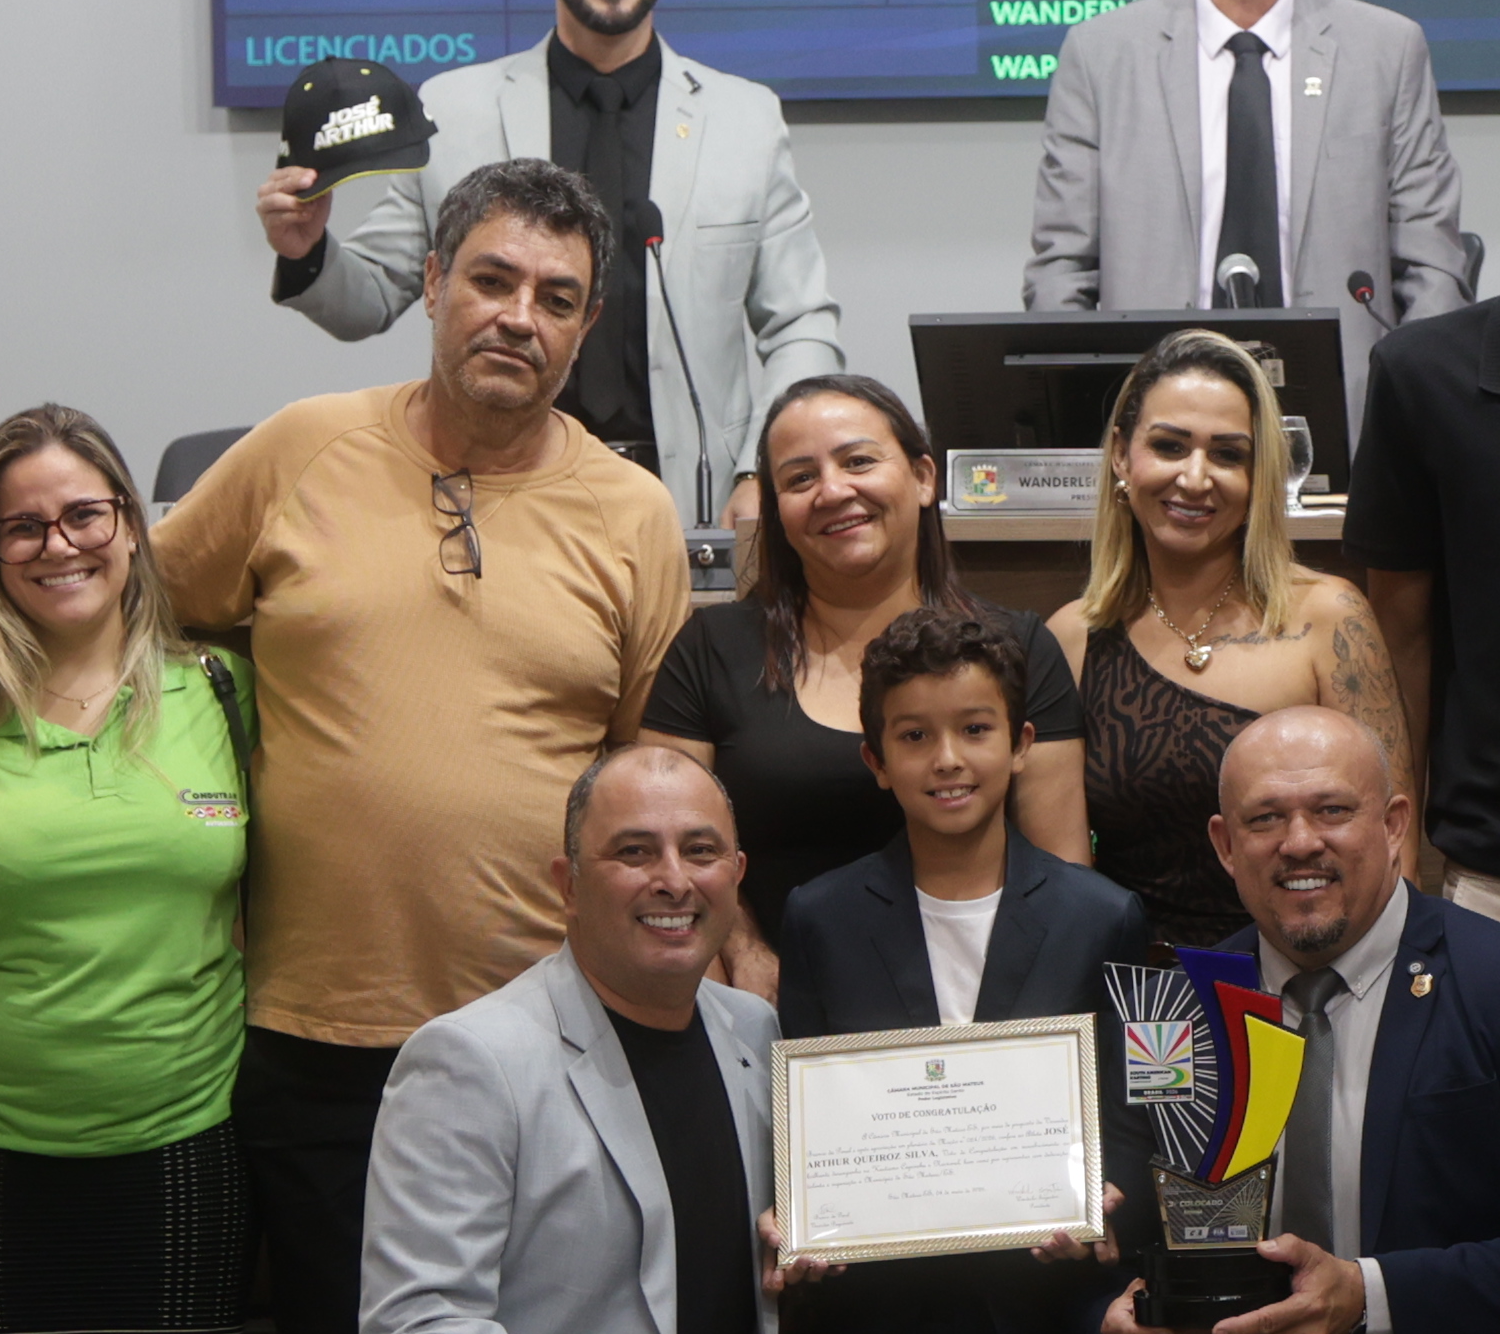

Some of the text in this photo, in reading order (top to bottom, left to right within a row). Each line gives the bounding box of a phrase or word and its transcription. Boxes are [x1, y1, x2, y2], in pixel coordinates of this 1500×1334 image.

[246, 35, 476, 67] LICENCIADOS
[321, 95, 381, 130] JOSÉ
[313, 113, 395, 151] ARTHUR
[1018, 475, 1097, 488] WANDERLEI
[871, 1103, 997, 1122] VOTO DE CONGRATULAÇÃO
[1044, 1124, 1070, 1136] JOSÉ
[806, 1157, 850, 1170] ARTHUR
[853, 1152, 902, 1166] QUEIROZ
